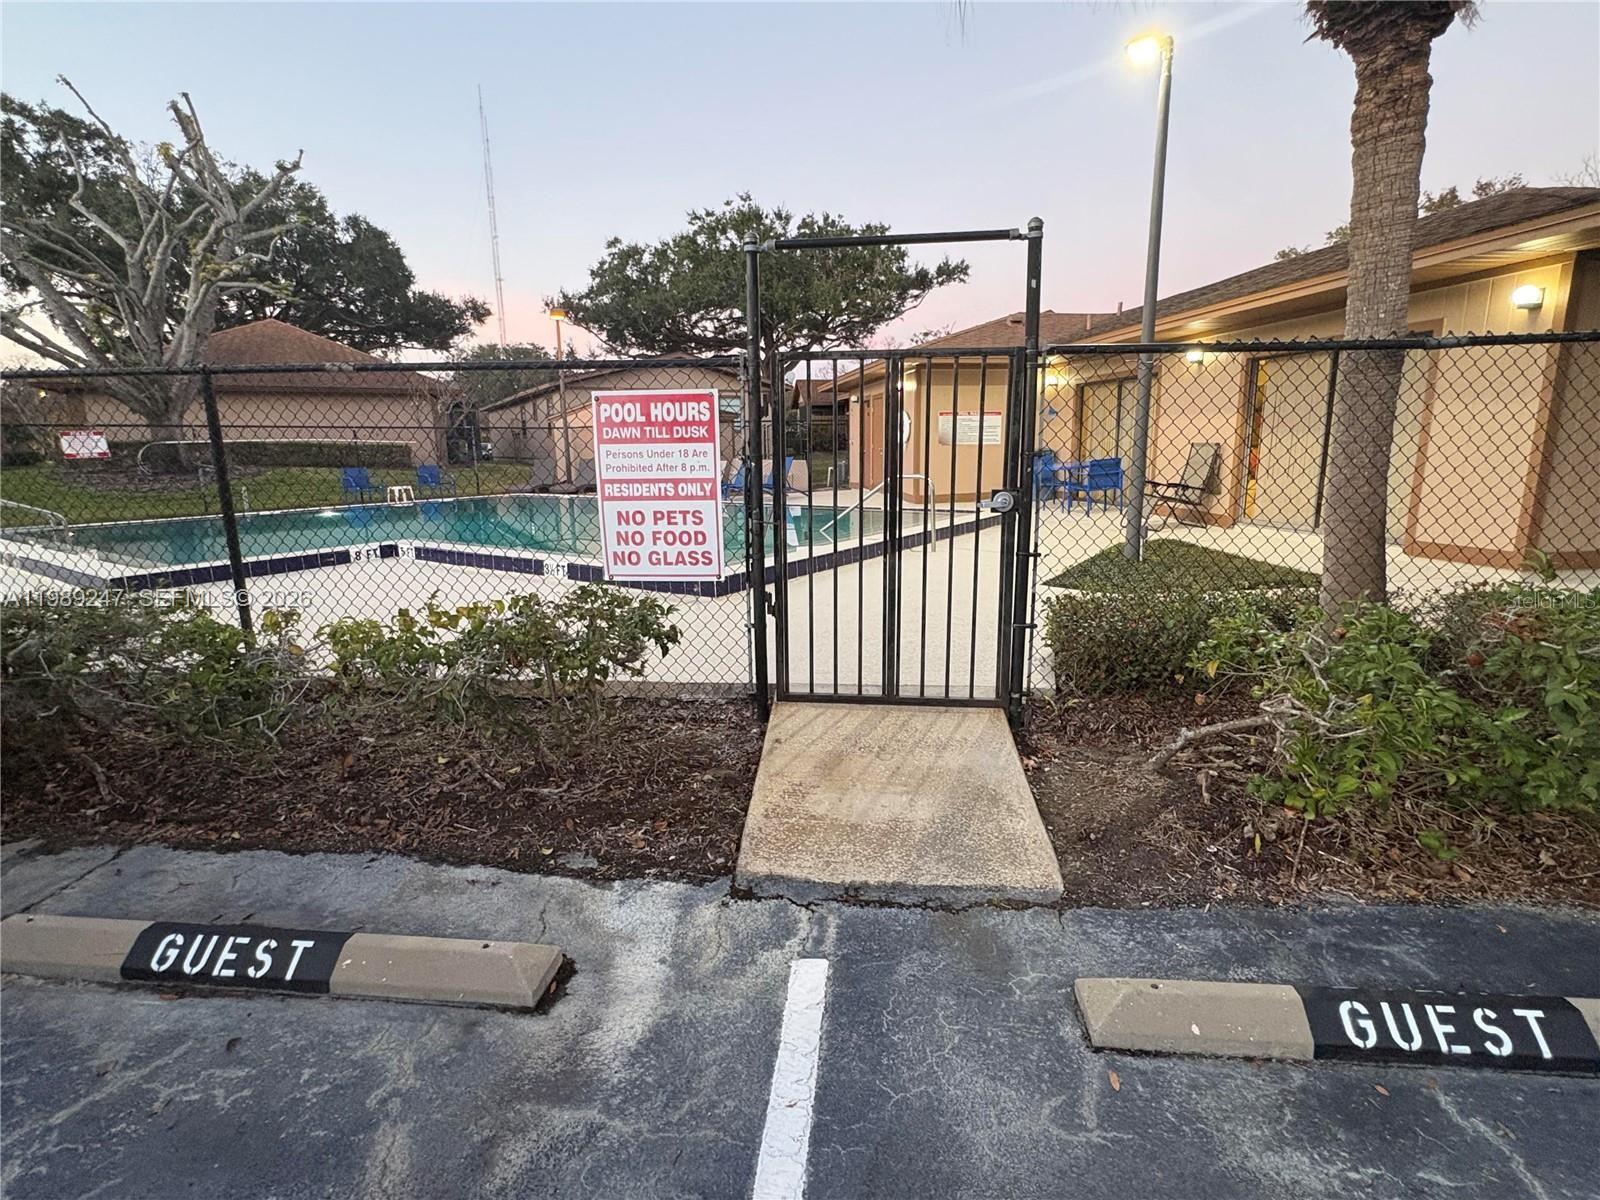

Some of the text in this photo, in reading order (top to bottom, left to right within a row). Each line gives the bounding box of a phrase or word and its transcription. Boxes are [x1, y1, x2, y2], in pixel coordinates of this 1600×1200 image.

[600, 401, 711, 423] POOL HOURS
[602, 425, 709, 439] DAWN TILL DUSK
[605, 448, 708, 460] Persons Under 18 Are
[605, 463, 710, 474] Prohibited After 8 p.m.
[604, 482, 713, 497] RESIDENTS ONLY
[616, 510, 704, 526] NO PETS
[616, 530, 707, 547] NO FOOD
[354, 548, 380, 561] 8 FT
[612, 550, 713, 567] NO GLASS
[149, 932, 316, 981] GUEST
[1338, 1000, 1554, 1059] GUEST
